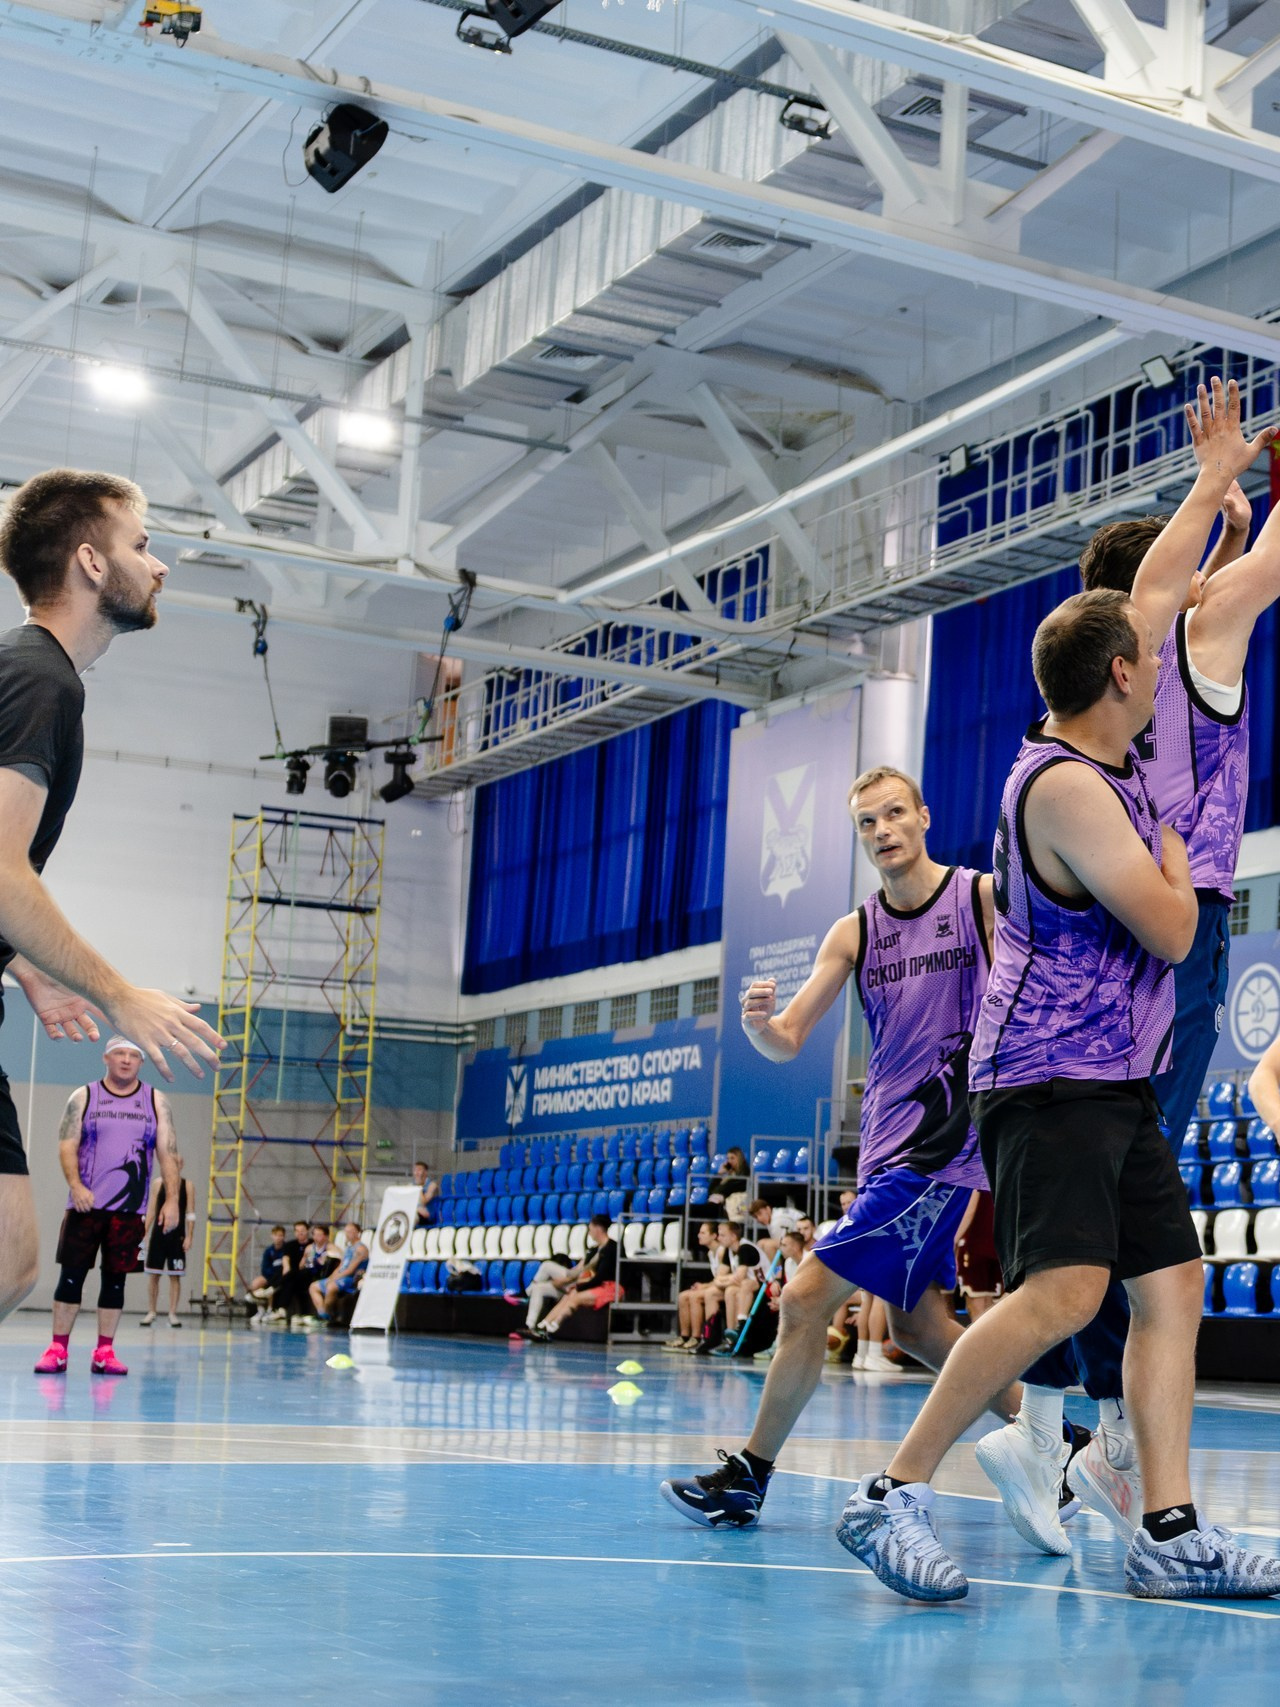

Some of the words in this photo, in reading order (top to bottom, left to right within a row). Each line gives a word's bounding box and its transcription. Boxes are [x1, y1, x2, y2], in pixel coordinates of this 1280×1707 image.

[534, 1053, 639, 1090] МИНИСТЕРСТВО
[642, 1044, 702, 1076] СПОРТА
[532, 1082, 629, 1116] ПРИМОРСКОГО
[631, 1077, 673, 1106] КРАЯ
